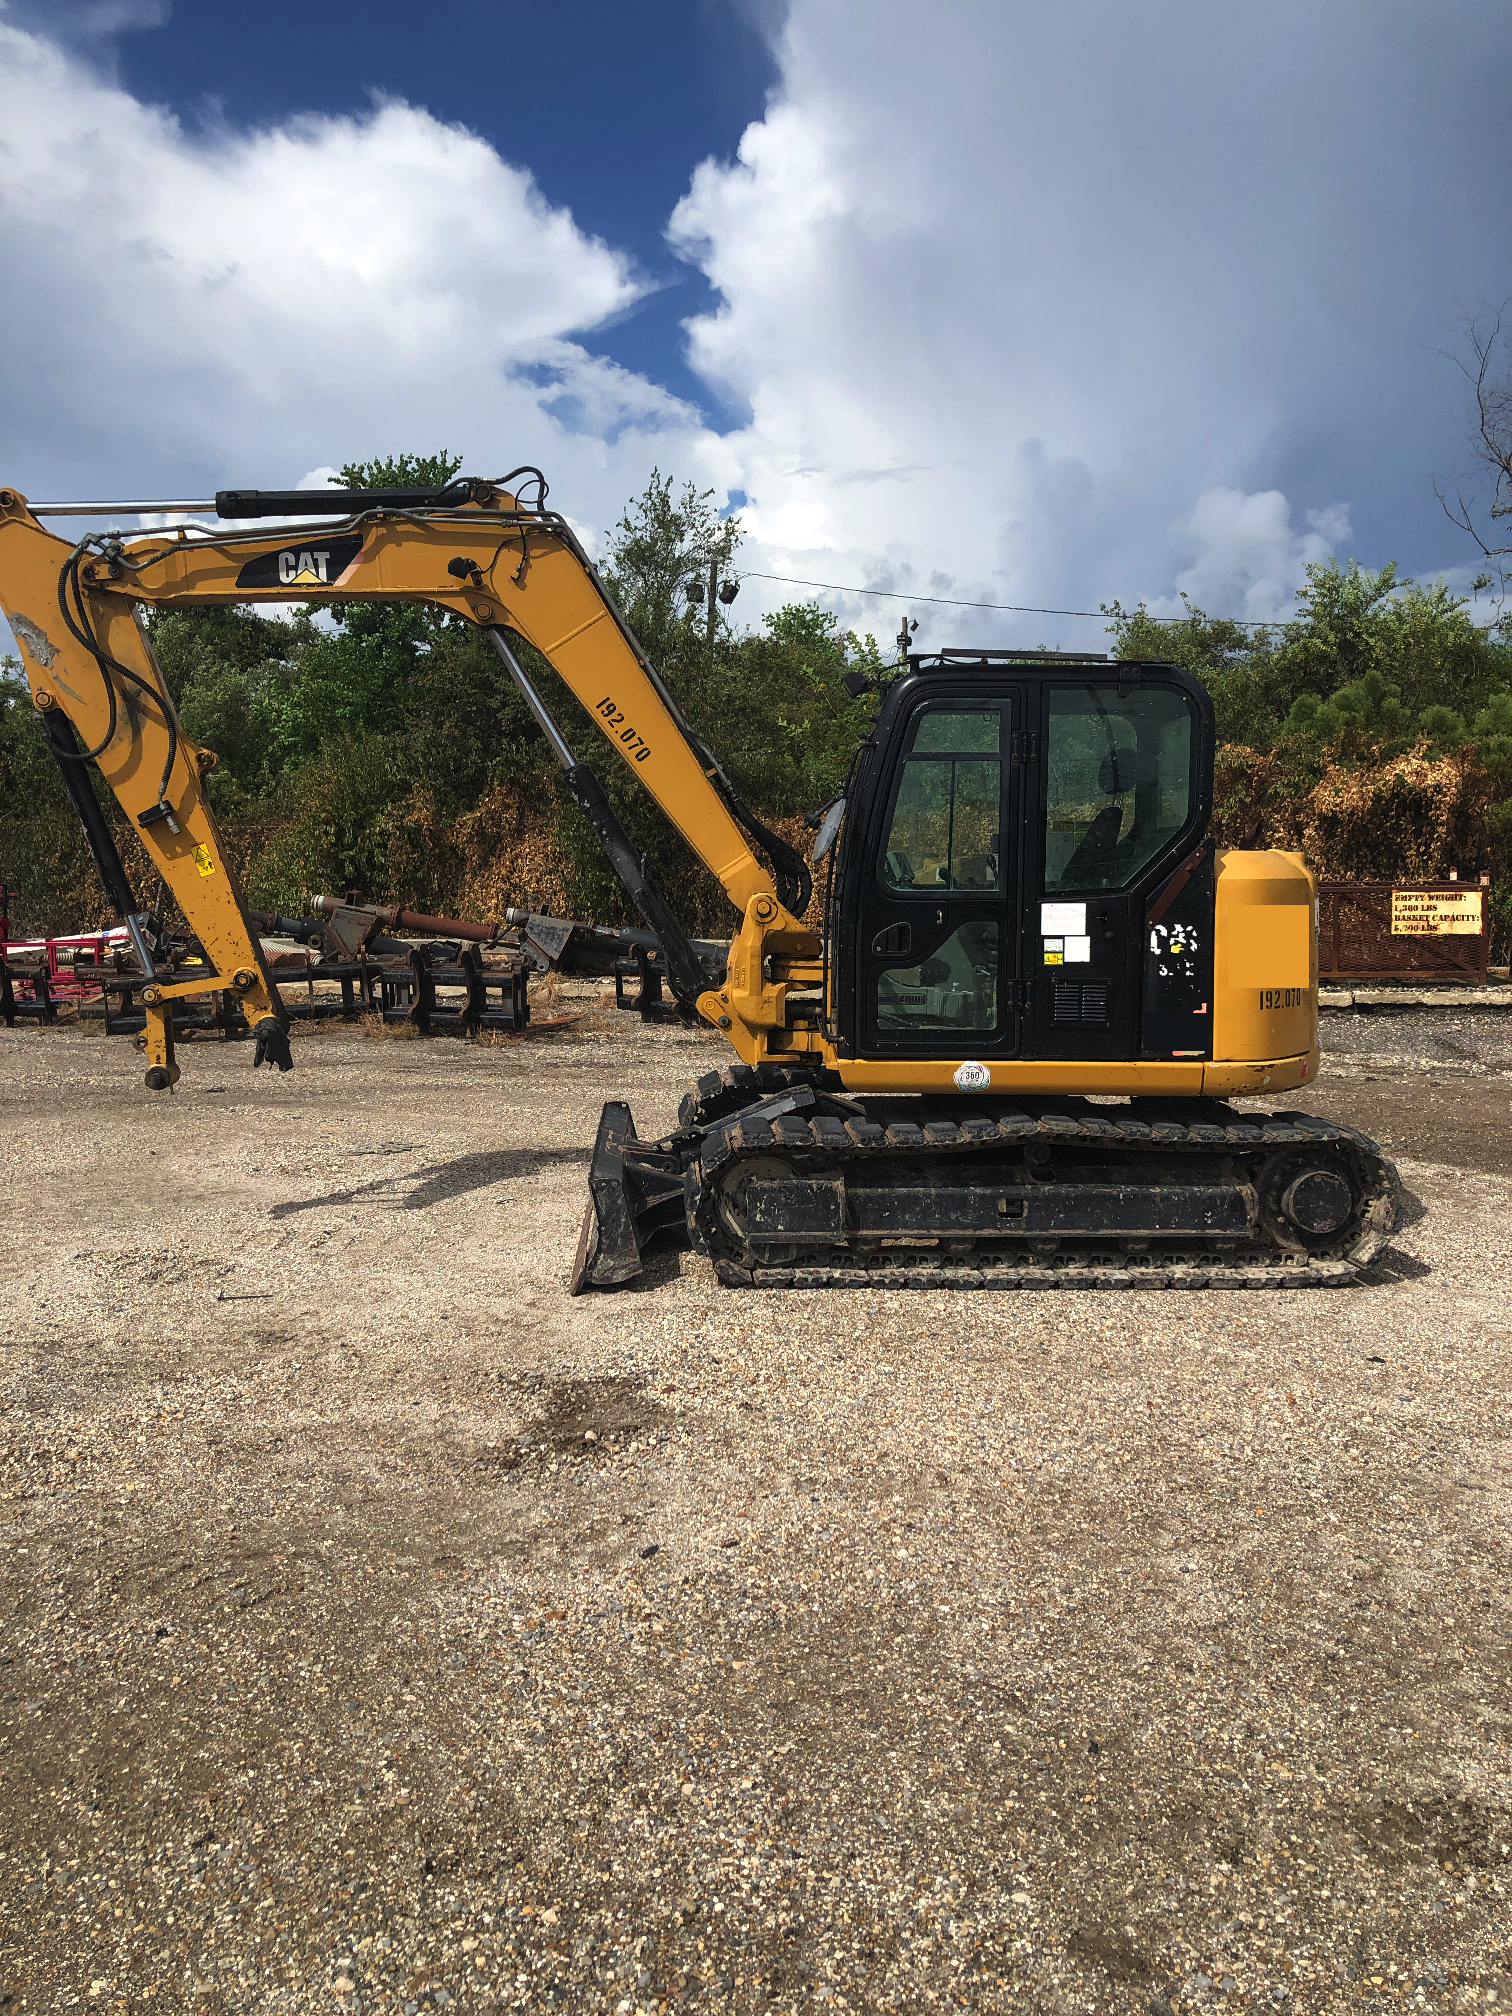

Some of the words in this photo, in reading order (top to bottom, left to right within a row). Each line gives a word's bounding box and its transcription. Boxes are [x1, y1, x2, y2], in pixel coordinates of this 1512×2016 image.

[278, 551, 331, 584] CAT
[595, 696, 652, 763] 192.070
[1427, 893, 1467, 901] WEIGHT:
[1259, 987, 1301, 1011] 192.070
[965, 1071, 980, 1079] 360
